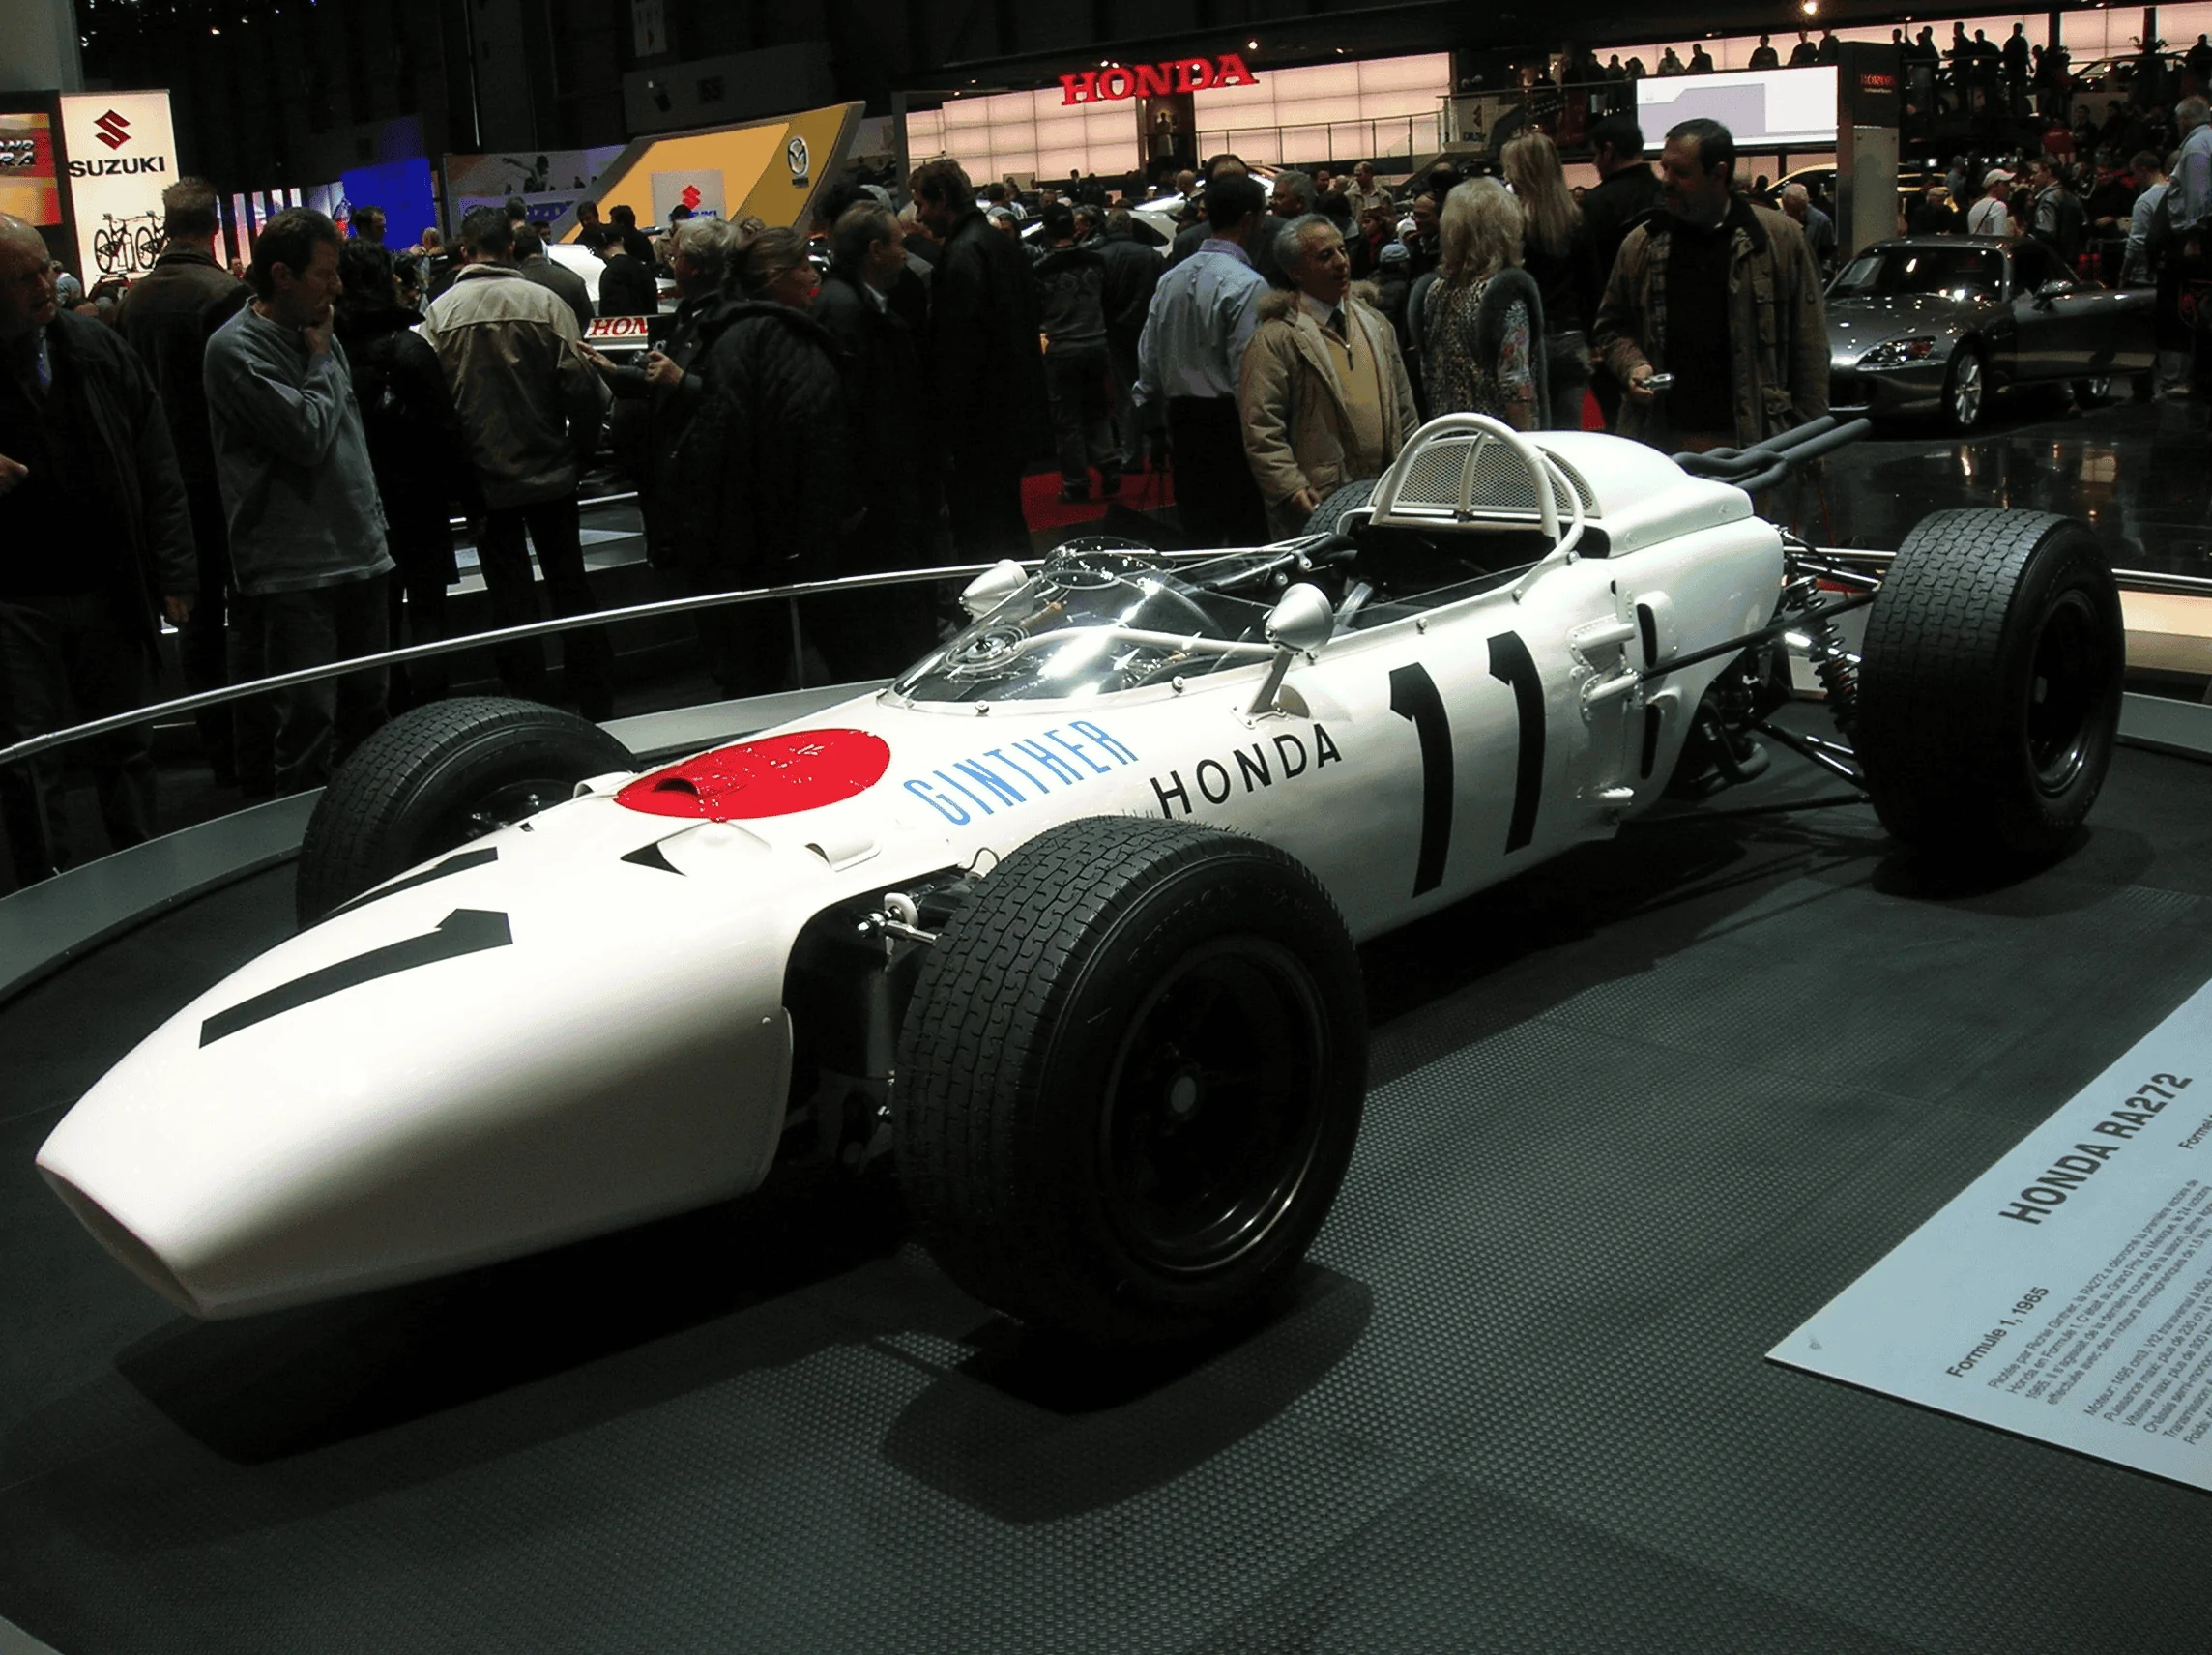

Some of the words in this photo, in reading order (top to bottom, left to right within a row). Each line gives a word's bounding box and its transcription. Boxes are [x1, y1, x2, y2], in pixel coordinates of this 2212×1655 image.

[1060, 53, 1260, 105] HONDA
[68, 156, 165, 178] SUZUKI
[903, 719, 1139, 826] GINTHER
[1150, 723, 1343, 820] HONDA
[1389, 630, 1547, 899] 11
[1998, 1142, 2120, 1225] HONDA
[2092, 1072, 2193, 1140] RA272
[1945, 1328, 2008, 1378] Formule
[2011, 1286, 2050, 1316] 1965
